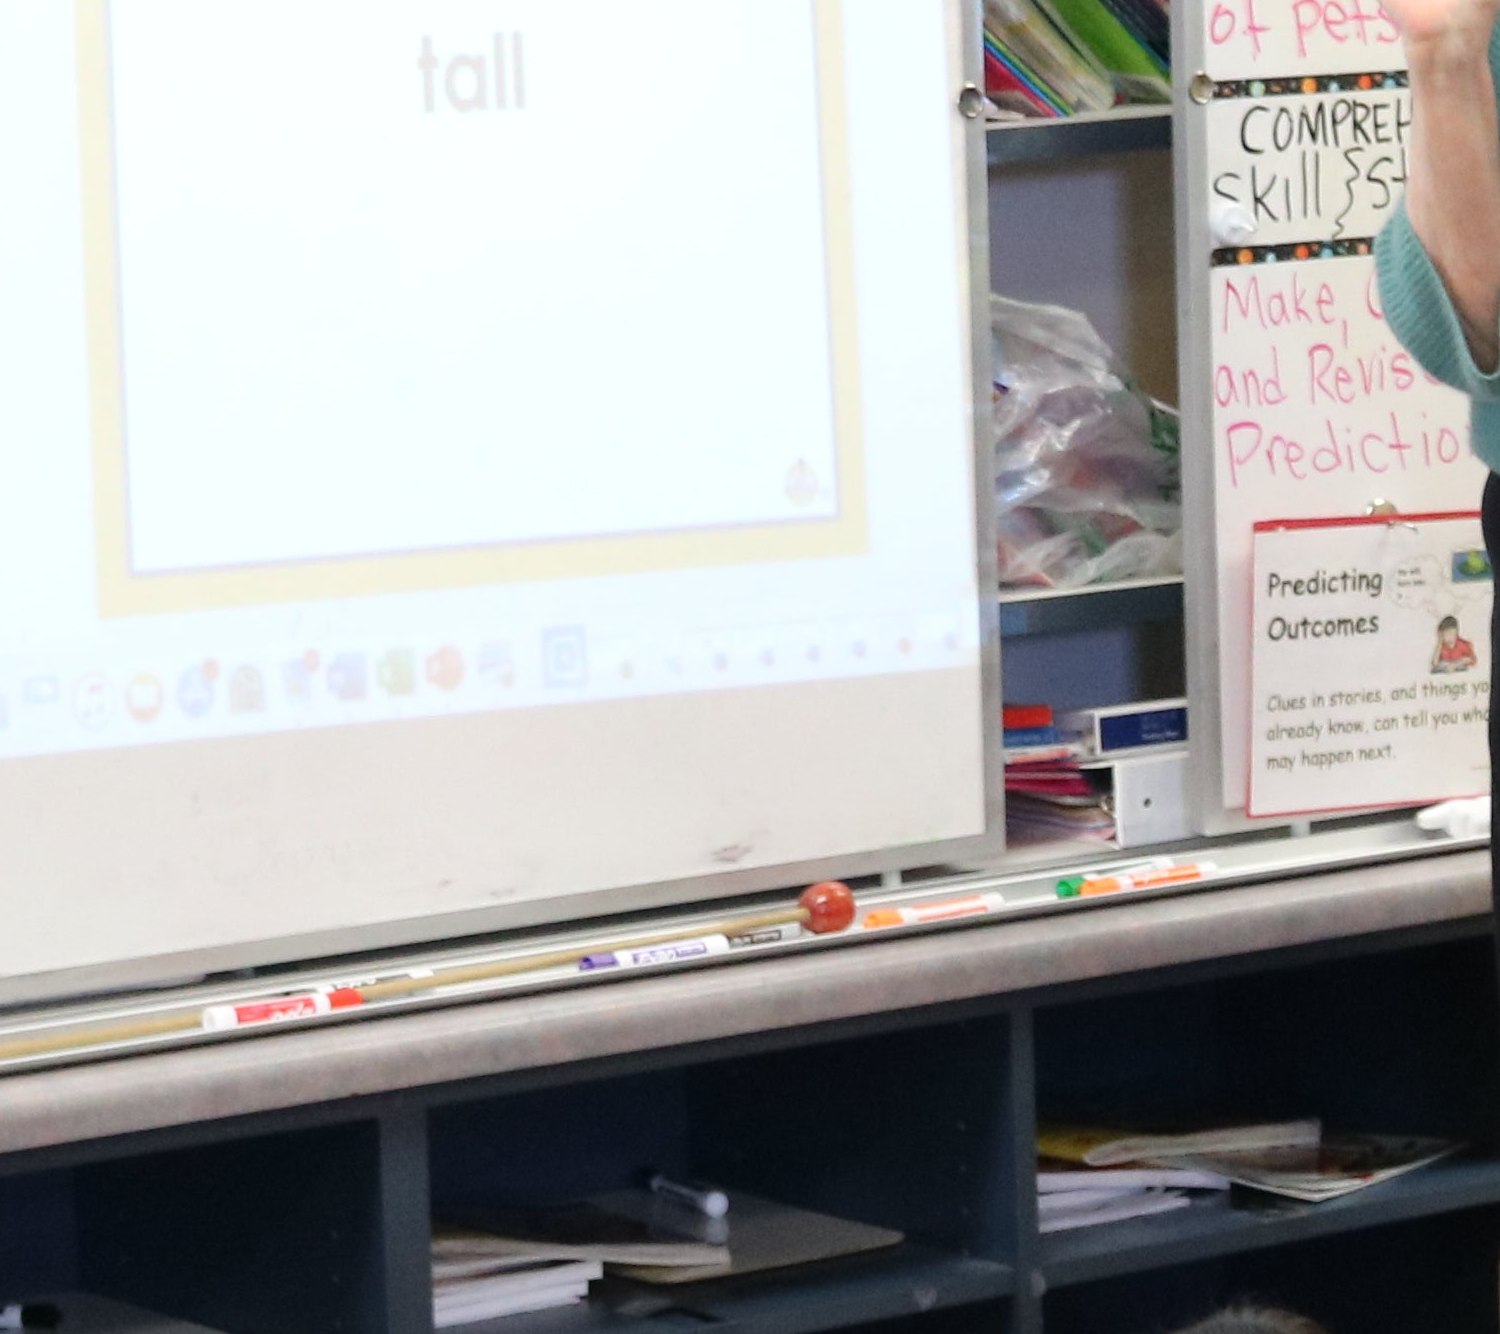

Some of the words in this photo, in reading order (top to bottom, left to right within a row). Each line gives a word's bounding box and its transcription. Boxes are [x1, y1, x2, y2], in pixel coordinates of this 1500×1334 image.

[416, 31, 527, 115] tall
[1213, 345, 1289, 409] and
[1267, 568, 1384, 599] Predicting
[1266, 614, 1381, 643] Outcomes
[1390, 682, 1418, 701] and
[1421, 677, 1468, 701] things
[1266, 719, 1322, 744] already
[1266, 754, 1298, 775] may
[1300, 744, 1355, 772] happen
